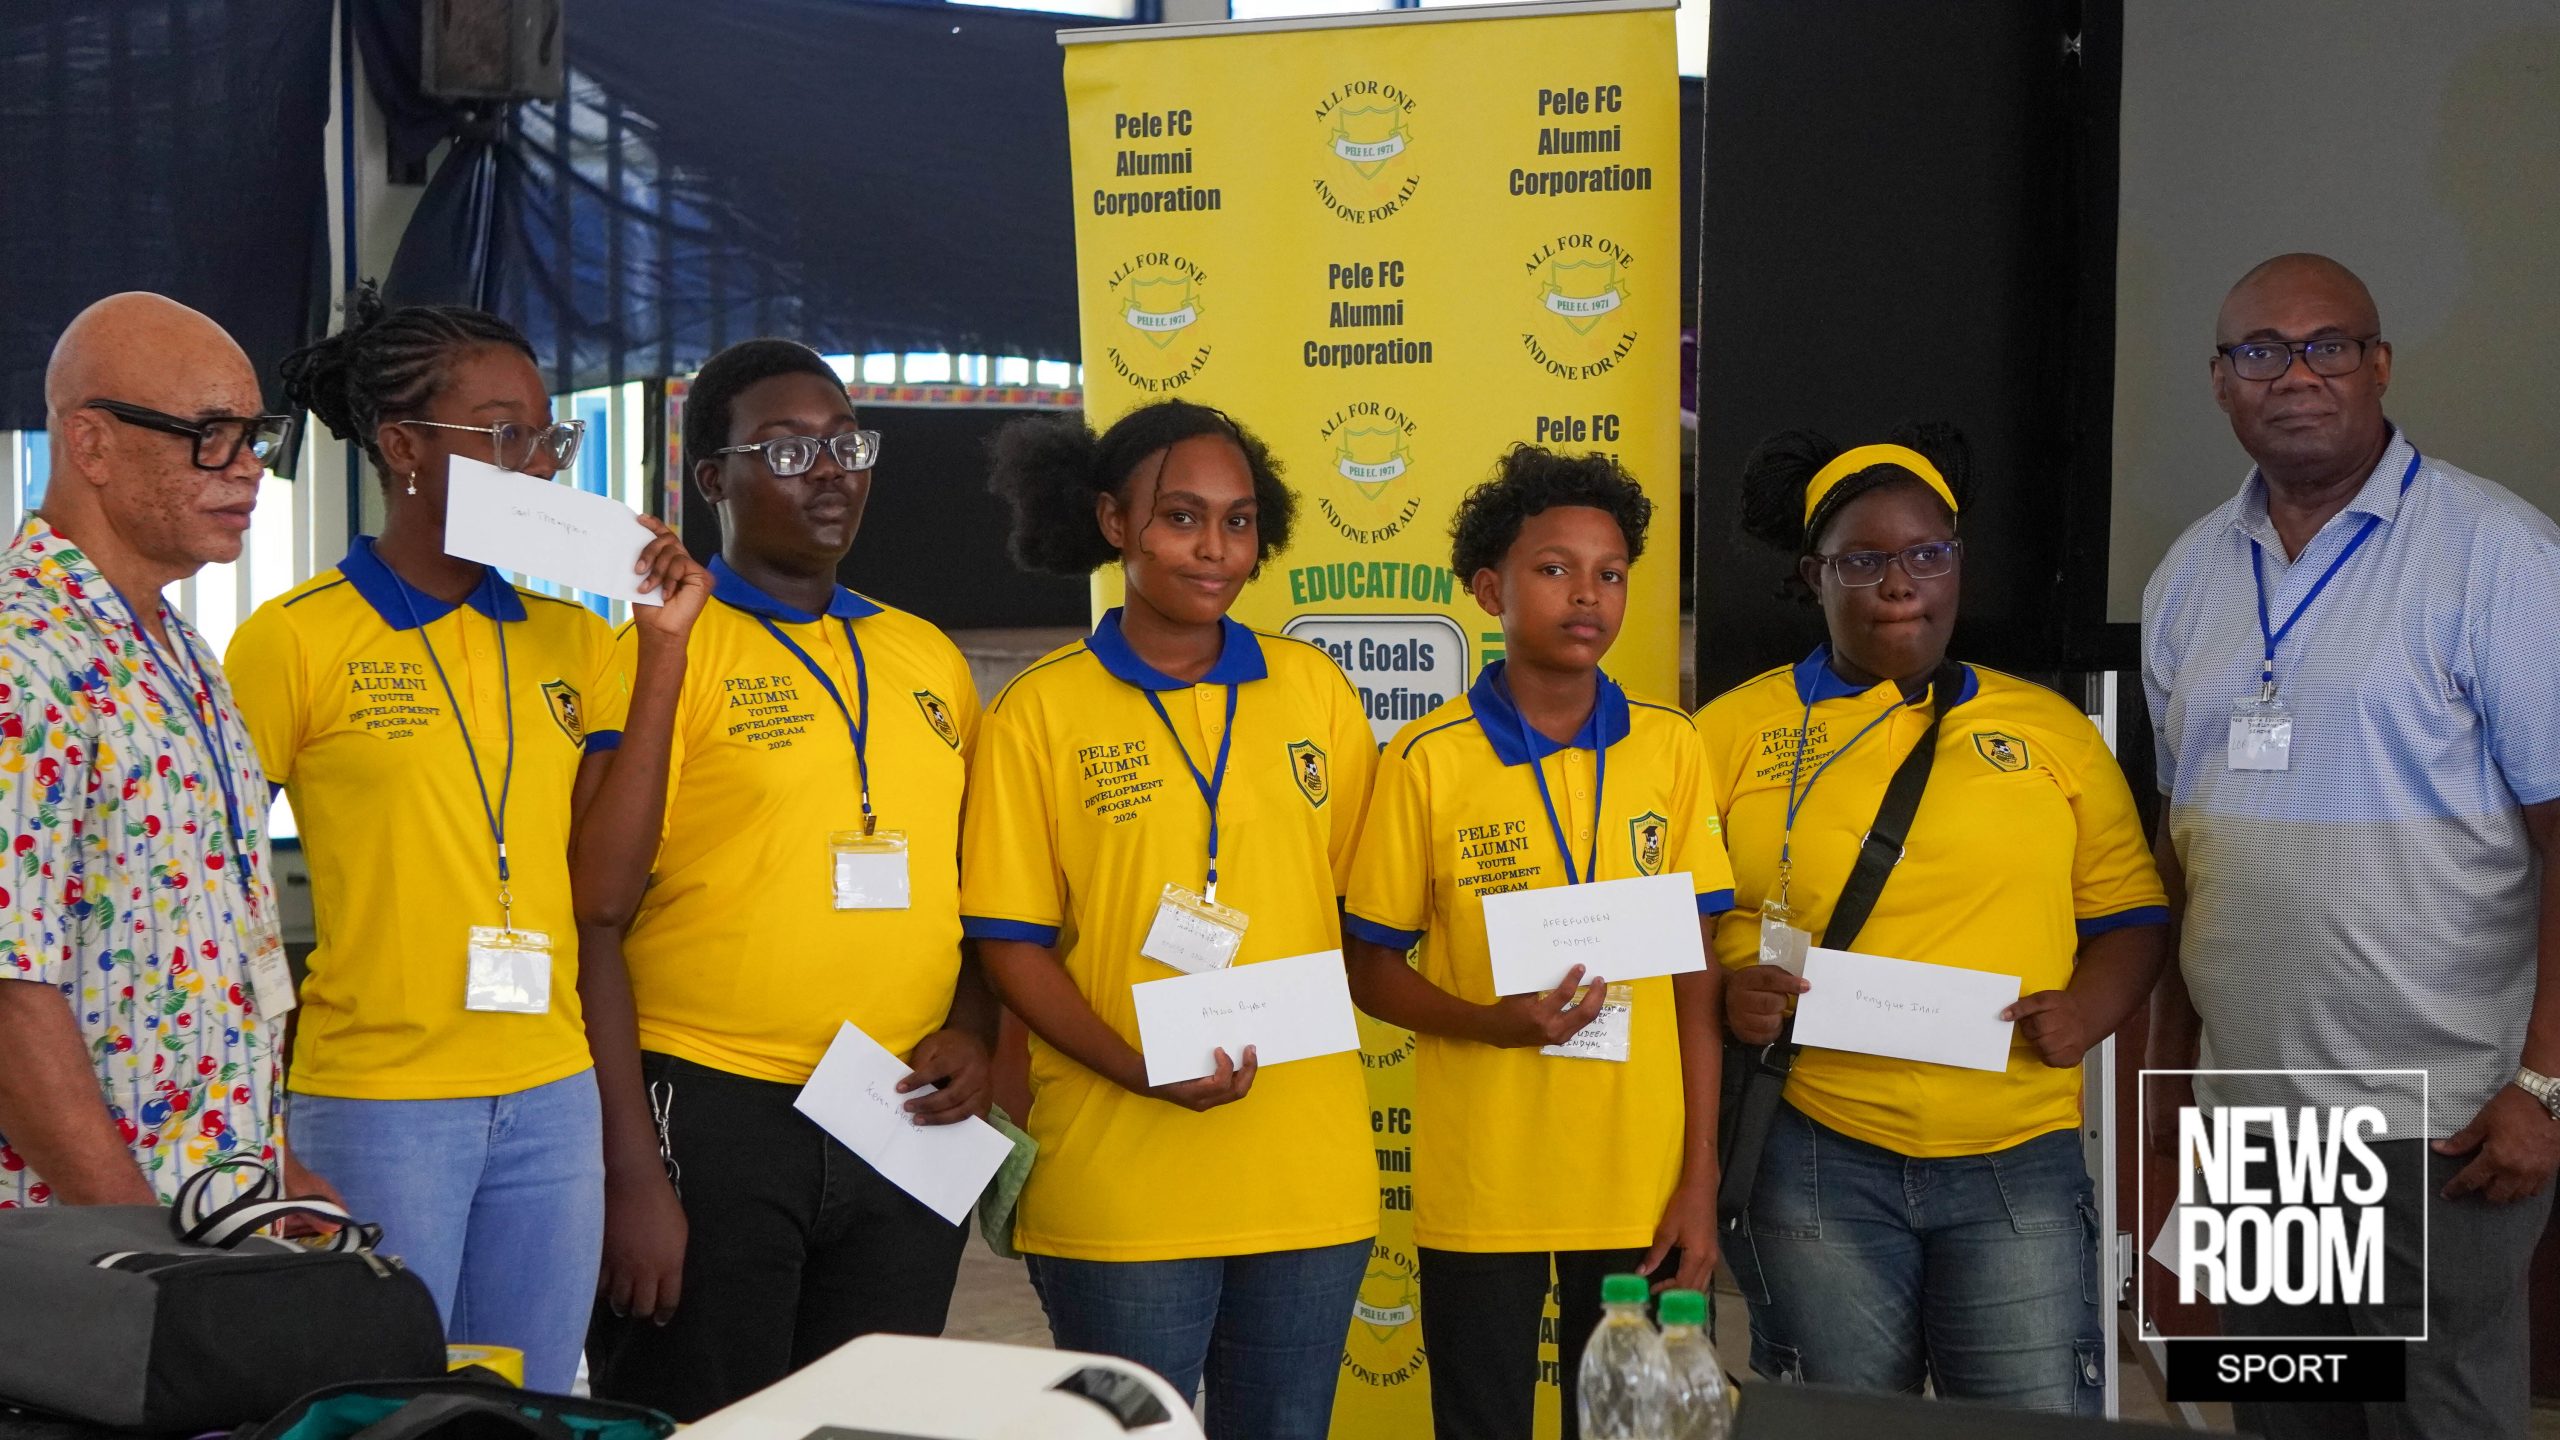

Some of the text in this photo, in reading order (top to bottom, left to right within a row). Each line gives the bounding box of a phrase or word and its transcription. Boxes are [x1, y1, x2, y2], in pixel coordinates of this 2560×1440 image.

[1315, 81, 1416, 122] ALL FOR ONE
[1538, 85, 1622, 116] Pele FC
[1116, 110, 1192, 139] Pele FC
[1377, 144, 1394, 156] 1971
[1538, 125, 1620, 155] Alumni
[1116, 148, 1192, 176] Alumni
[1510, 164, 1652, 197] Corporation
[1094, 186, 1221, 216] Corporation
[1314, 175, 1420, 224] AND ONE FOR ALL
[1525, 234, 1634, 276] ALL FOR ONE
[1108, 252, 1207, 292] ALL FOR ONE
[1329, 260, 1404, 289] Pele FC
[1330, 299, 1403, 328] Alumni
[1592, 299, 1609, 310] 1971
[1169, 314, 1186, 326] 1971
[1304, 338, 1432, 368] Corporation
[1522, 330, 1638, 380] AND ONE FOR ALL
[1107, 344, 1212, 392] AND ONE FOR ALL
[1321, 402, 1416, 442] ALL FOR ONE
[1536, 414, 1620, 442] Pele FC
[1379, 466, 1395, 476] 1971
[1319, 496, 1420, 544] AND ONE FOR ALL
[1288, 562, 1454, 606] EDUCATION
[1359, 638, 1434, 672] Goals
[347, 662, 423, 676] PELE FC
[352, 678, 427, 693] ALUMNI
[724, 676, 792, 692] PELE FC
[370, 694, 414, 702] YOUTH
[730, 689, 798, 708] ALUMNI
[350, 706, 440, 723] DEVELOPMENT
[748, 704, 788, 716] YOUTH
[366, 718, 428, 730] PROGRAM
[387, 730, 414, 740] 2026
[728, 714, 814, 736] DEVELOPMENT
[747, 726, 805, 742] PROGRAM
[1761, 722, 1826, 742] PELE FC
[768, 738, 792, 750] 2026
[1078, 740, 1146, 764] PELE FC
[1084, 754, 1150, 780] ALUMNI
[1096, 772, 1138, 788] YOUTH
[1084, 779, 1164, 808] DEVELOPMENT
[1097, 794, 1152, 816] PROGRAM
[1114, 810, 1138, 824] 2026
[1458, 820, 1526, 842] PELE FC
[1461, 836, 1528, 860] ALUMNI
[1476, 856, 1516, 870] YOUTH
[1458, 866, 1541, 887] DEVELOPMENT
[1474, 881, 1528, 897] PROGRAM
[1378, 1048, 1406, 1068] FOR
[1388, 1107, 1412, 1134] FC
[1352, 1364, 1379, 1386] ONE
[1382, 1367, 1410, 1387] FOR
